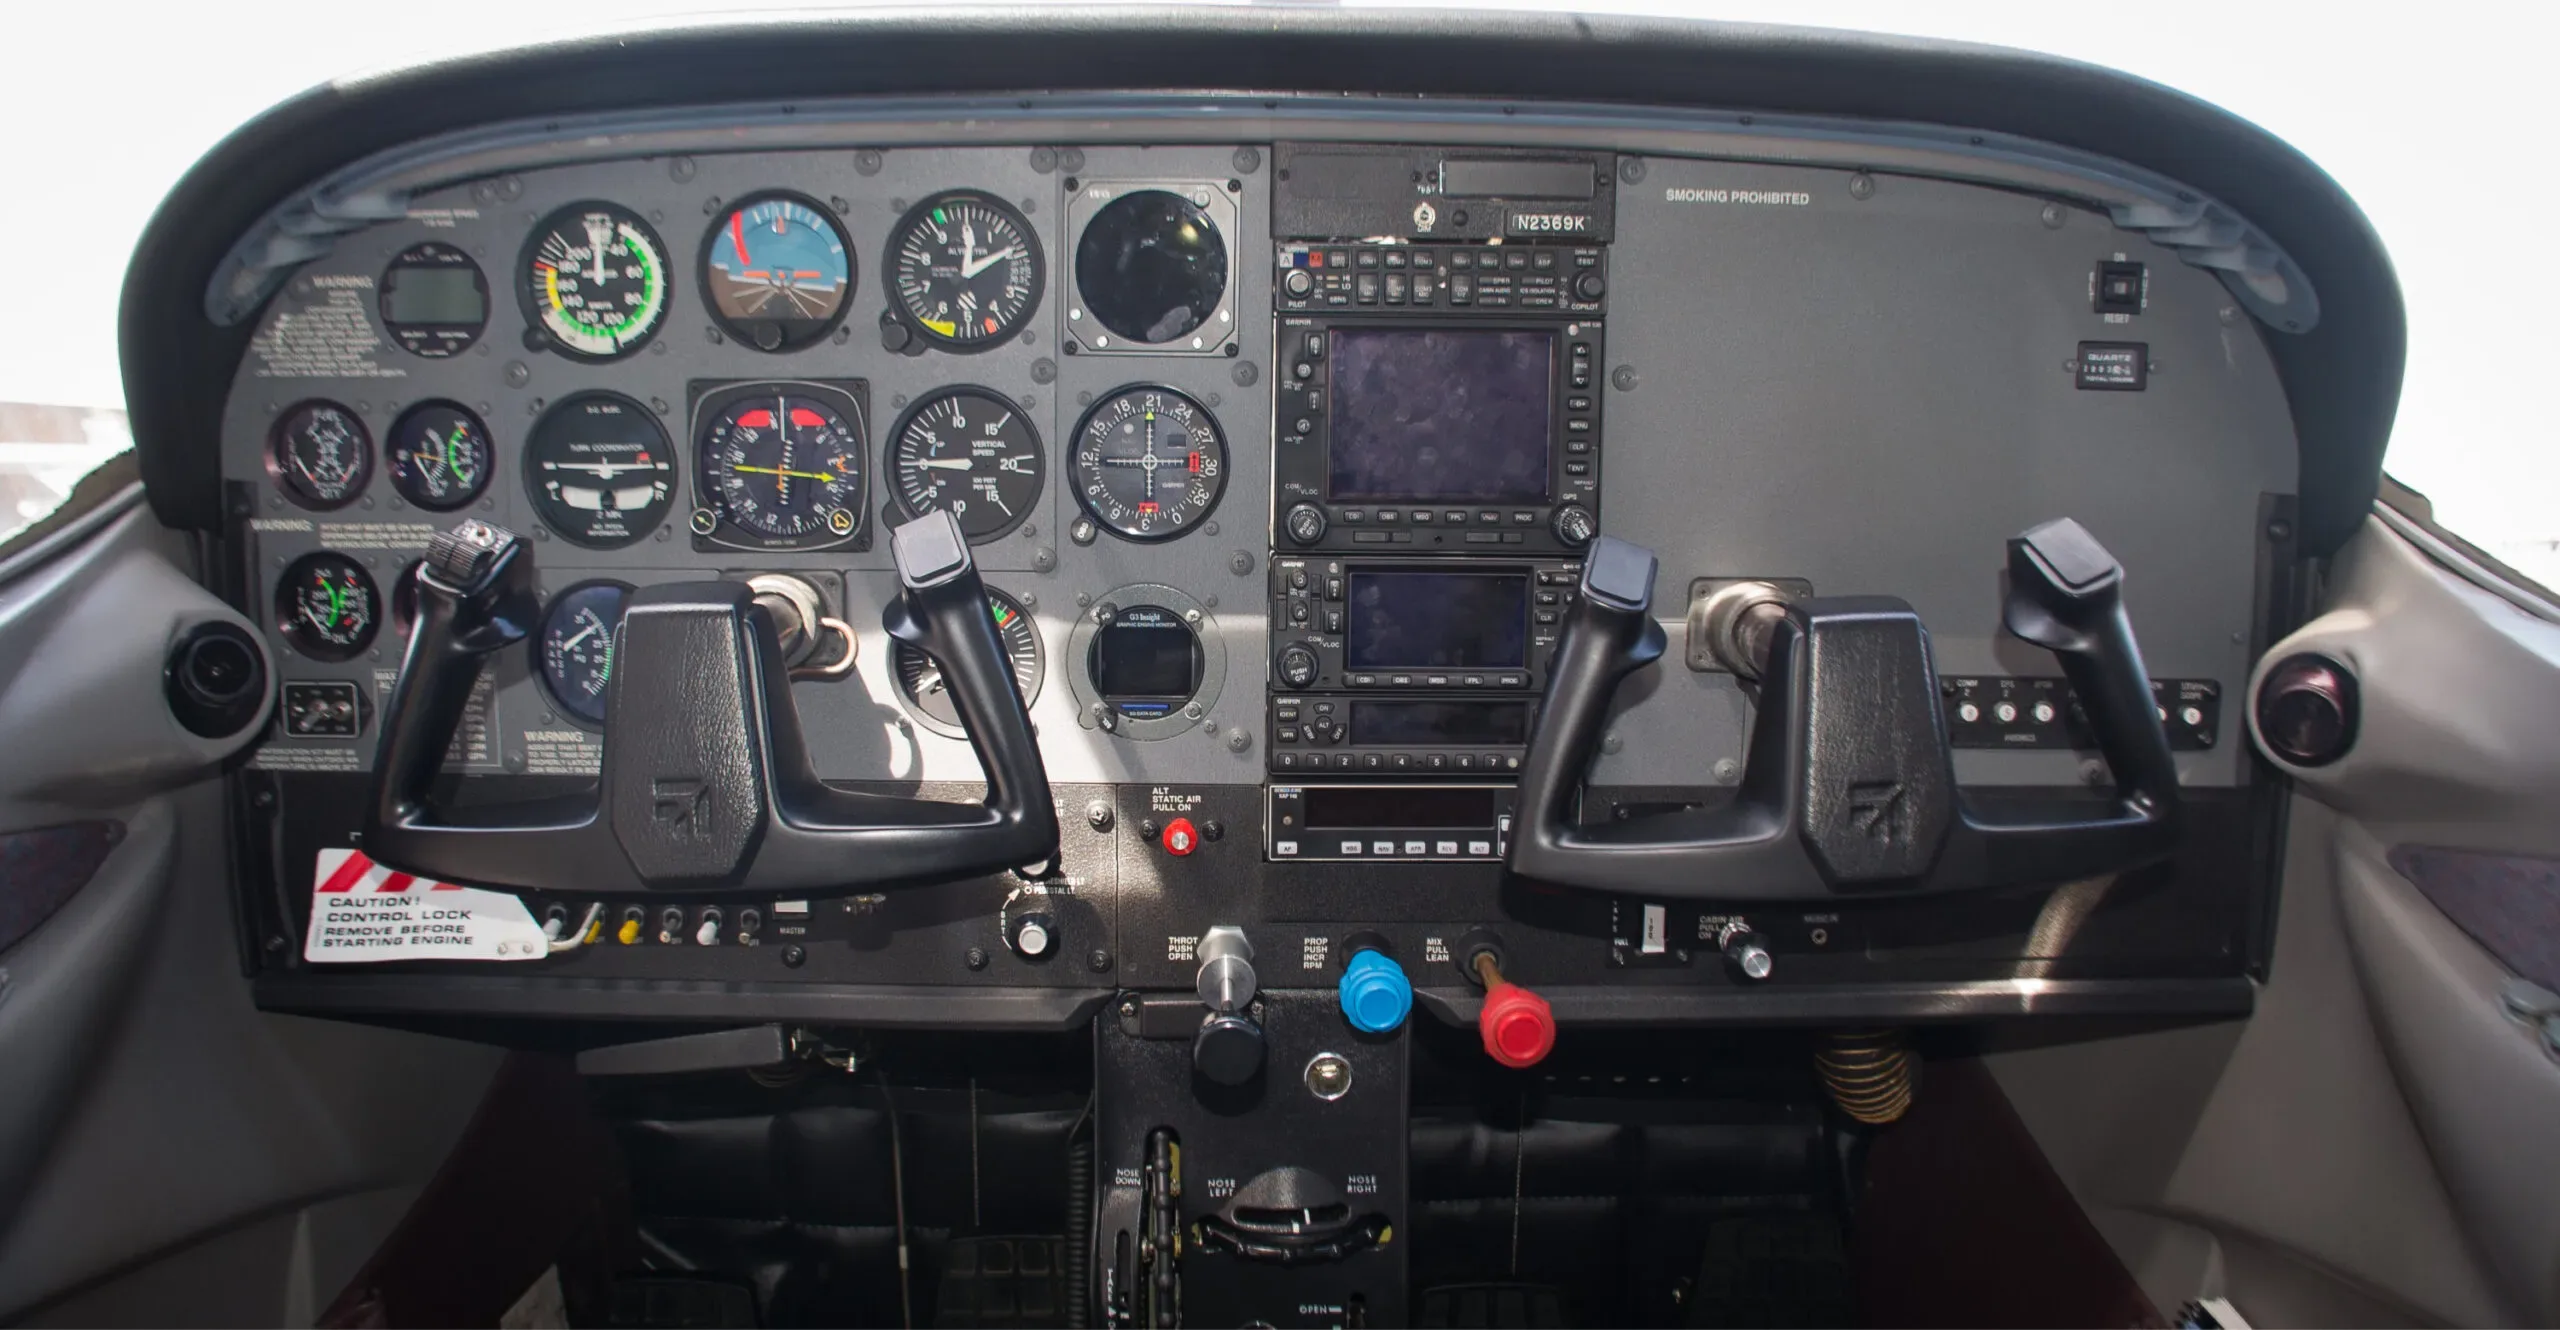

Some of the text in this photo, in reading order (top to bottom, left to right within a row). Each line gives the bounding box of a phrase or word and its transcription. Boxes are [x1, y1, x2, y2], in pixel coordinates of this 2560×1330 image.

[1666, 188, 1810, 205] SMOKING PROHIBITED
[1517, 214, 1586, 231] N2369K
[937, 231, 948, 245] 9
[987, 230, 993, 244] 1
[565, 247, 592, 261] 200
[610, 244, 628, 257] 40
[921, 252, 932, 266] 8
[1359, 257, 1377, 265] COM1
[1387, 258, 1405, 266] COM2
[1414, 258, 1432, 266] COM3
[2113, 252, 2127, 262] ON
[625, 266, 644, 279] 60
[312, 275, 374, 289] WARNING
[922, 280, 931, 294] 7
[1005, 285, 1015, 299] 3
[624, 292, 643, 306] 80
[938, 301, 948, 314] 6
[989, 300, 999, 312] 4
[577, 310, 599, 324] 120
[603, 312, 626, 326] 100
[964, 309, 973, 323] 5
[2087, 353, 2132, 363] QUARTZ
[1145, 394, 1161, 407] 21
[1114, 400, 1131, 416] 18
[1174, 403, 1193, 420] 24
[952, 416, 966, 428] 10
[1089, 420, 1106, 436] 15
[985, 423, 999, 436] 15
[1197, 427, 1214, 444] 27
[927, 431, 937, 444] 5
[592, 443, 645, 452] COORDINATOR
[971, 440, 1007, 449] VERTICAL
[972, 449, 995, 457] SPEED
[999, 458, 1018, 471] 20
[1081, 451, 1094, 468] 12
[1205, 458, 1218, 477] 30
[551, 489, 560, 501] L
[654, 489, 665, 501] R
[928, 485, 938, 498] 5
[986, 489, 1000, 502] 15
[1088, 484, 1101, 496] 9
[1193, 488, 1209, 507] 33
[952, 500, 966, 512] 10
[1077, 522, 1089, 539] OBS
[1141, 518, 1150, 531] 3
[1129, 613, 1160, 622] G3 Insight
[524, 730, 584, 742] WARNING
[1303, 725, 1315, 741] STBY
[1334, 728, 1343, 740] OFF
[1284, 757, 1291, 765] 0
[1342, 758, 1349, 766] 2
[1371, 758, 1377, 766] 3
[1399, 758, 1406, 766] 4
[1434, 758, 1441, 767] 5
[1461, 758, 1468, 767] 6
[1491, 758, 1497, 766] 7
[1152, 787, 1169, 795] ALT
[1152, 795, 1184, 804] STATIC
[329, 896, 421, 908] CAUTION!
[327, 910, 472, 923] CONTROL LOCK
[1699, 915, 1745, 924] CABIN AIR
[324, 924, 466, 936] REMOVE BEFORE
[779, 926, 806, 935] MASTER
[1698, 924, 1721, 932] PULL
[323, 936, 473, 947] STARTING ENGINE
[1168, 936, 1198, 945] THROT
[1303, 937, 1329, 946] PROP
[1698, 931, 1713, 940] ON
[1426, 938, 1443, 946] MIX
[1614, 938, 1629, 946] FULL
[1168, 944, 1193, 953] PUSH
[1303, 945, 1328, 954] PUSH
[1426, 946, 1449, 954] PULL
[1168, 952, 1193, 961] OPEN
[1303, 953, 1326, 962] INCR
[1426, 954, 1449, 962] LEAN
[1303, 961, 1323, 970] RPM
[1116, 1168, 1140, 1177] NOSE
[1115, 1176, 1141, 1186] DOWN
[1207, 1178, 1236, 1189] NOSE
[1348, 1175, 1377, 1185] NOSE
[1209, 1187, 1235, 1198] LEFT
[1347, 1184, 1378, 1194] RIGHT
[1300, 1304, 1328, 1314] OPEN
